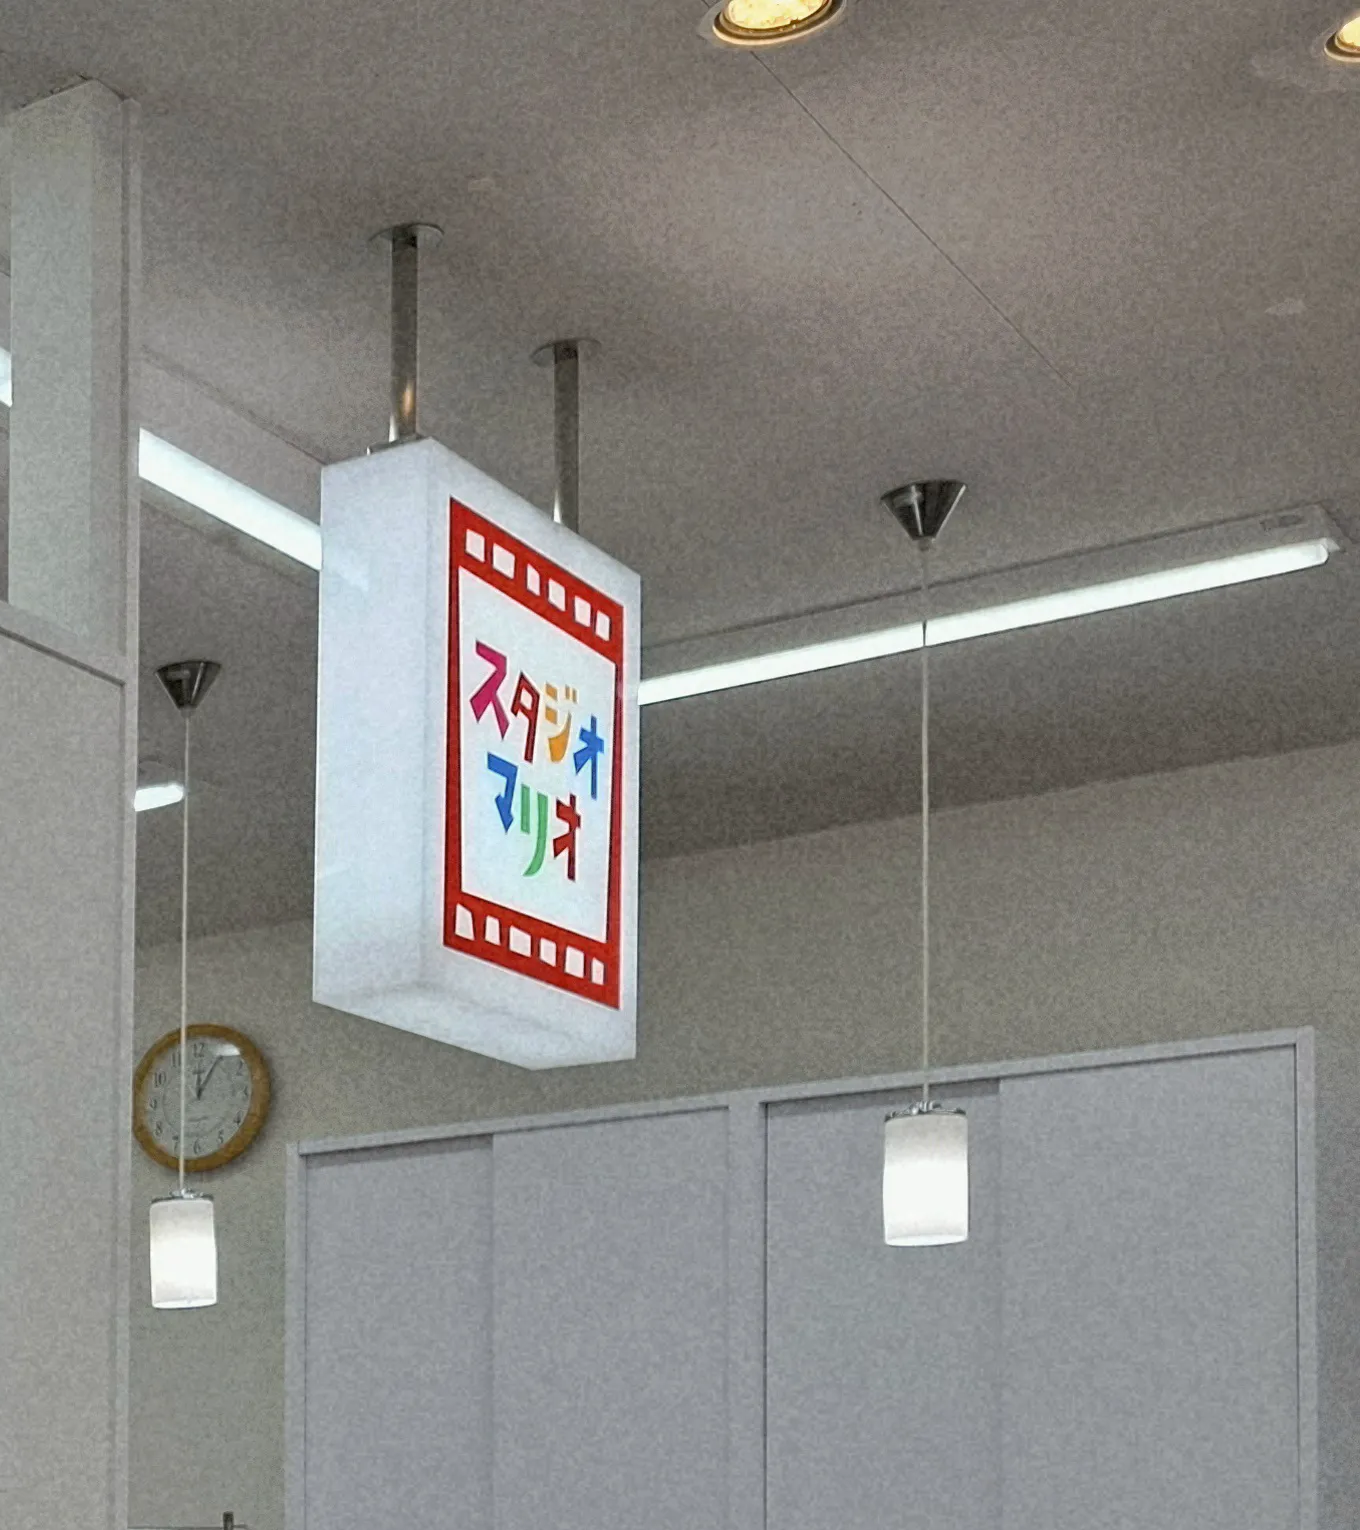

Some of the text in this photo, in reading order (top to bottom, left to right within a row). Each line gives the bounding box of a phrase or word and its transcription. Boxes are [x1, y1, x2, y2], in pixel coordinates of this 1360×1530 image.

[469, 639, 605, 800] スタジオ
[486, 751, 581, 882] マリオ
